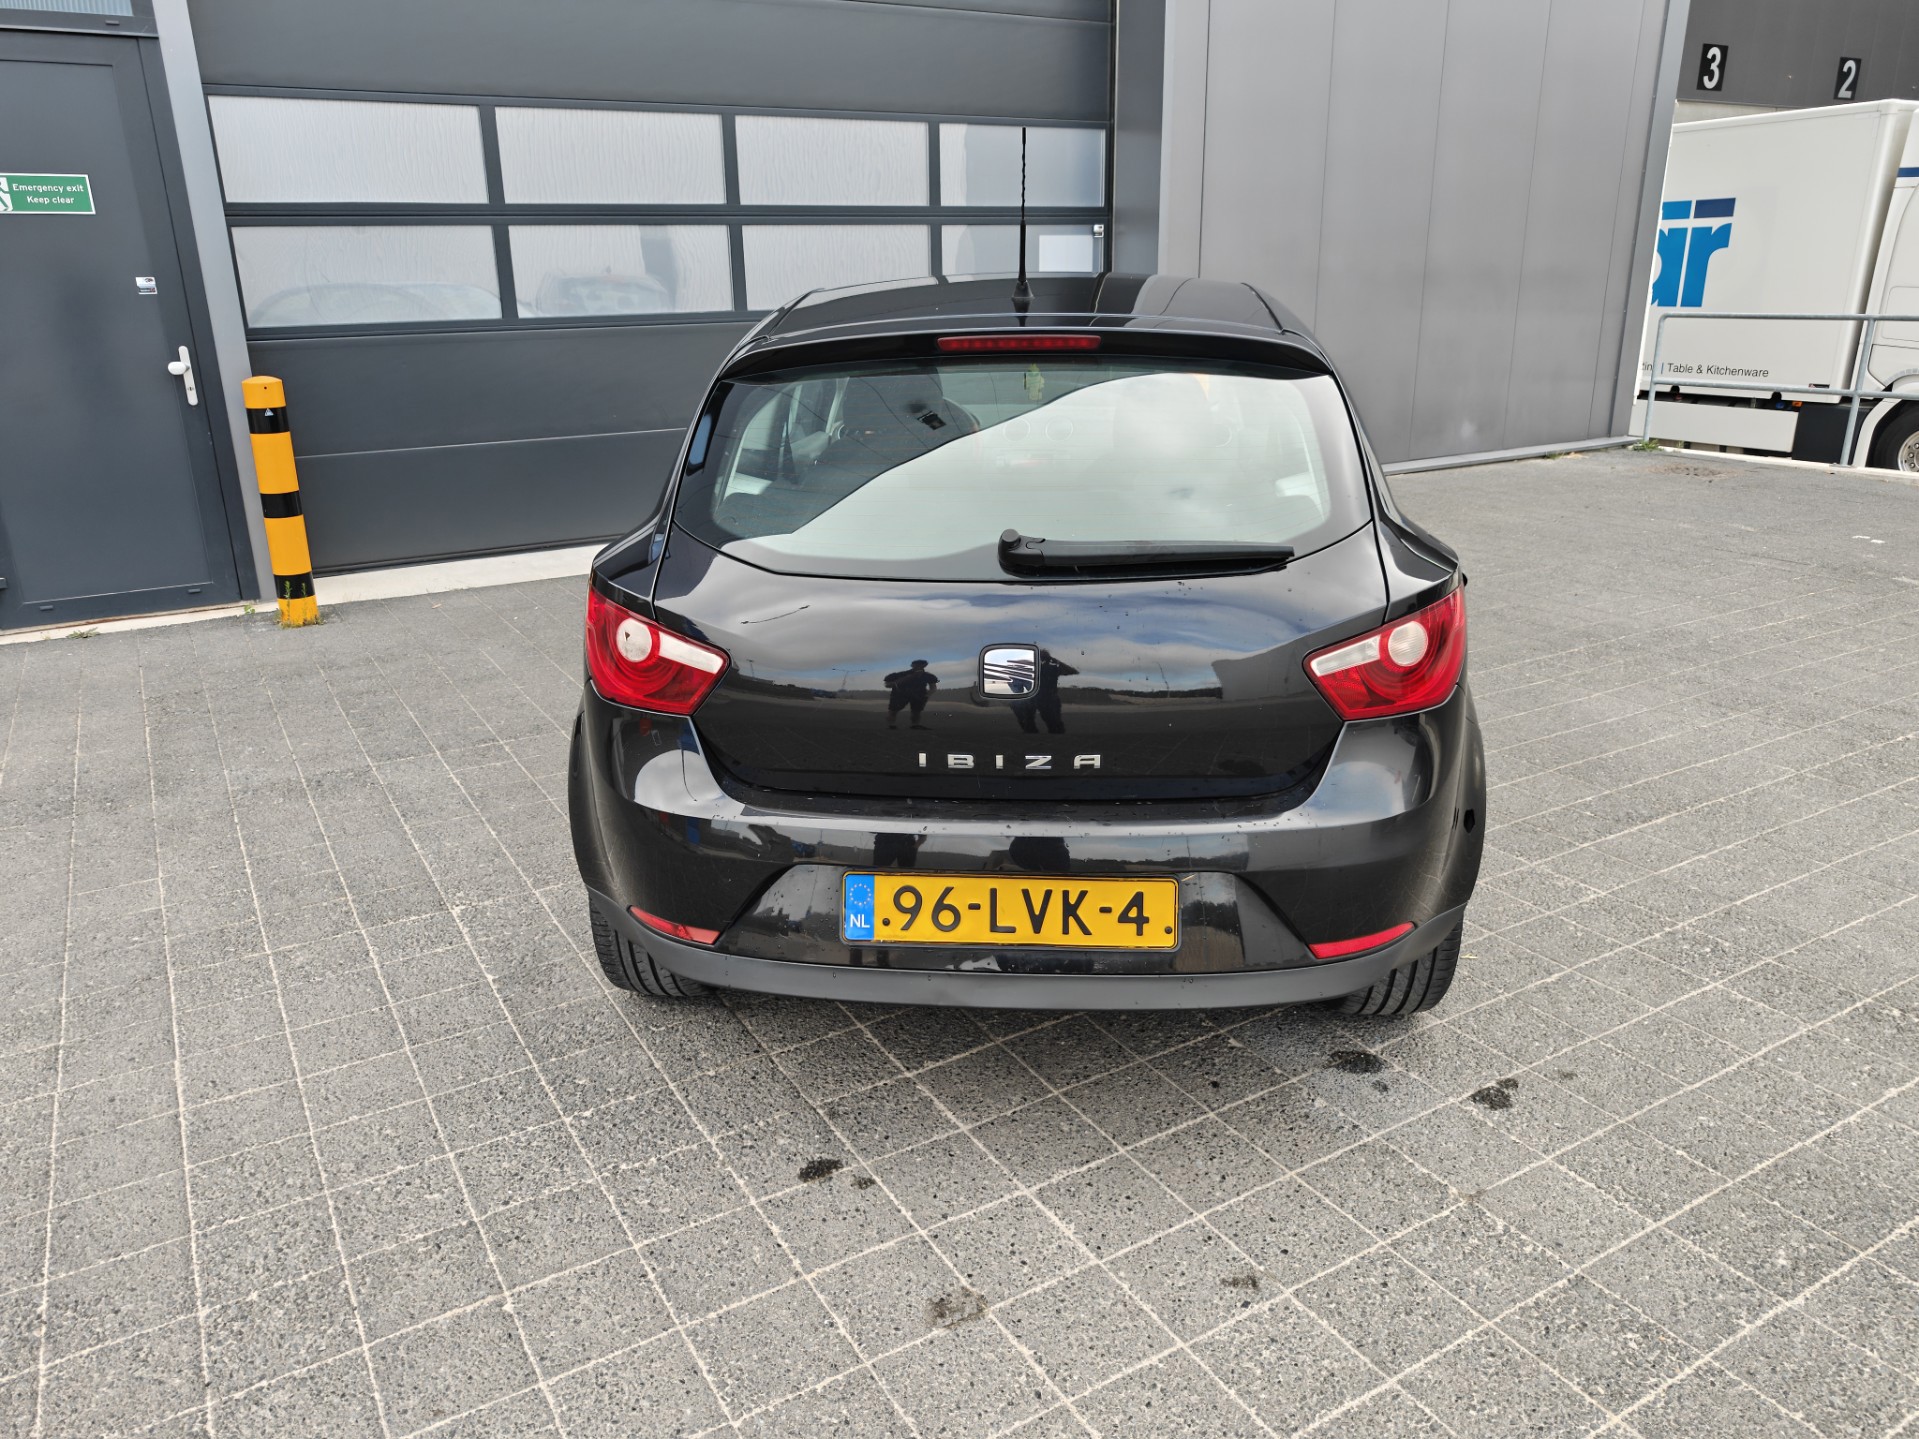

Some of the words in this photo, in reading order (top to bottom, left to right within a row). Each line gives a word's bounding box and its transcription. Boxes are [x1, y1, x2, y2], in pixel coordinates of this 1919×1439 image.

[1703, 46, 1721, 89] 3
[1837, 60, 1856, 98] 2
[12, 183, 64, 193] Emergency
[66, 184, 84, 192] exit
[27, 195, 50, 204] Keep
[52, 196, 75, 204] clear
[1667, 363, 1693, 373] Table
[1696, 364, 1703, 374] &
[1706, 365, 1769, 377] Kitchenware
[918, 753, 1101, 770] IBIZA
[893, 885, 1150, 936] 96-LVK-4
[850, 914, 870, 928] NL
